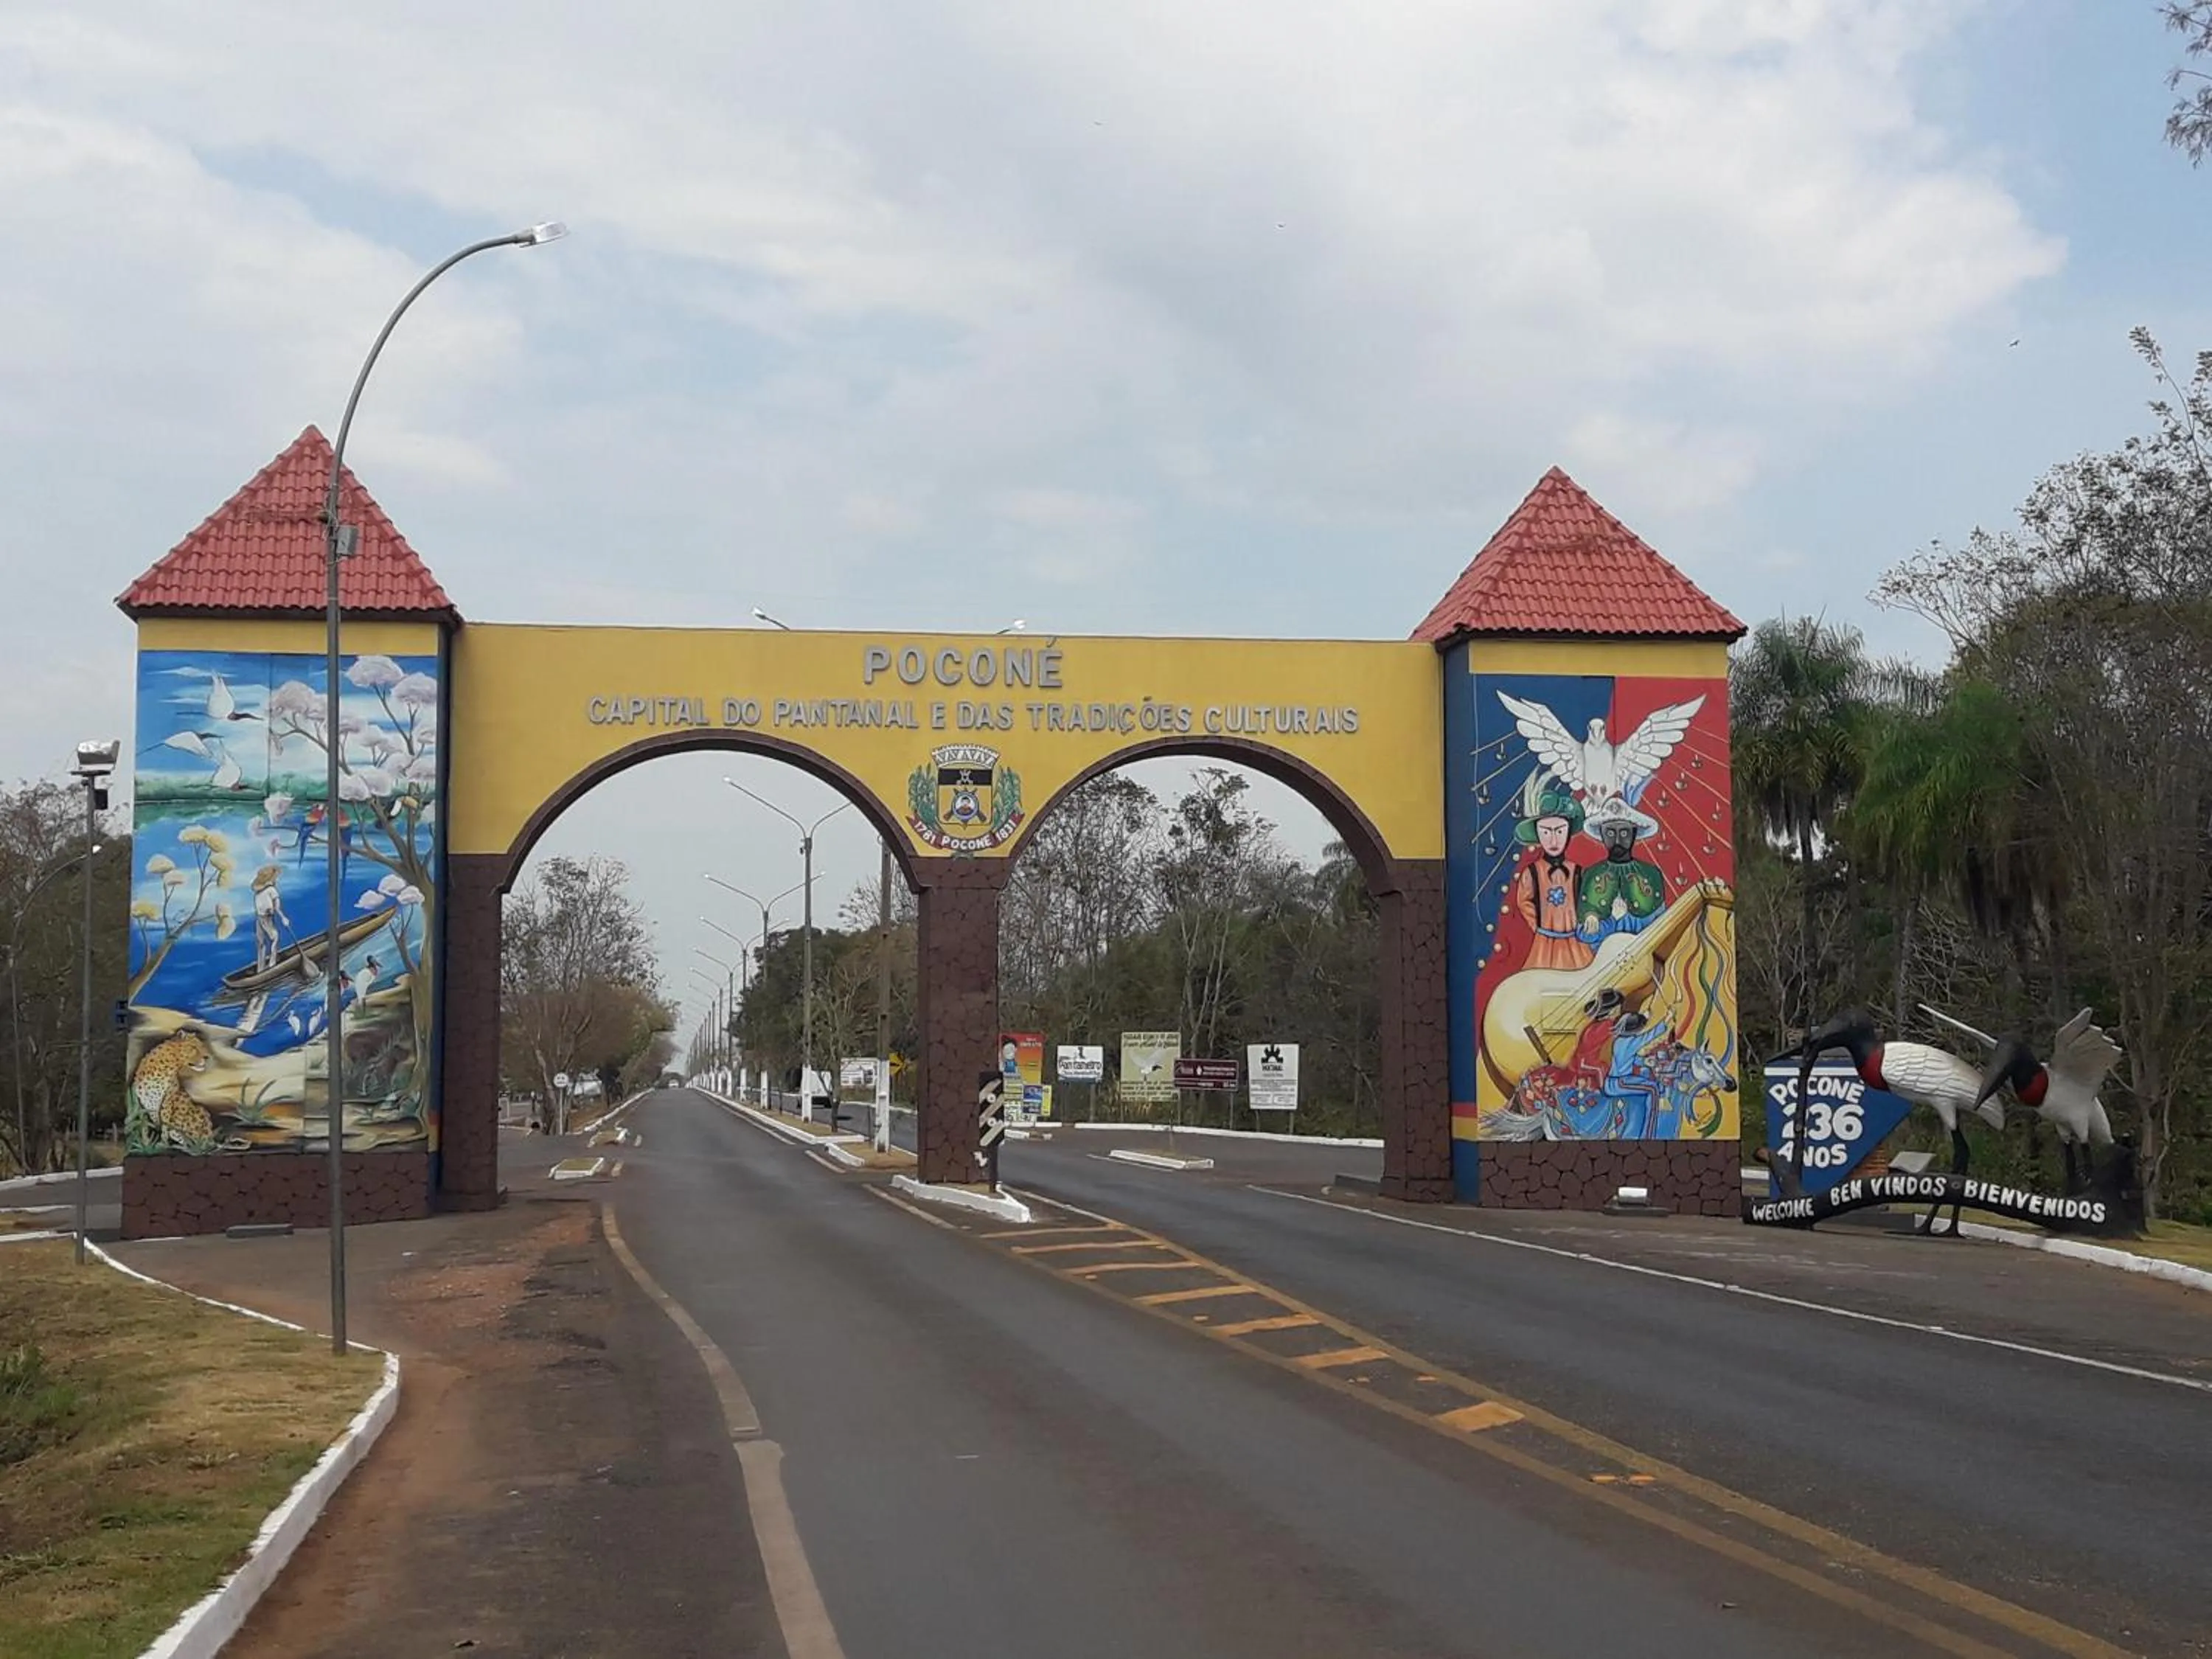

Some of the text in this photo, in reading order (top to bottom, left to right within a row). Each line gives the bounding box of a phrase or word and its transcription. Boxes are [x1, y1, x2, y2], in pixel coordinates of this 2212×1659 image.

[863, 637, 1062, 687] POCONÉ
[589, 696, 1359, 735] CAPITAL DO PANTANAL E DAS TRADIÇÕES CULTURAIS
[914, 821, 937, 844] 1781
[995, 818, 1018, 841] 1831
[1752, 1175, 2107, 1224] WELCOME BEN VINDOS BIENVENIDOS
